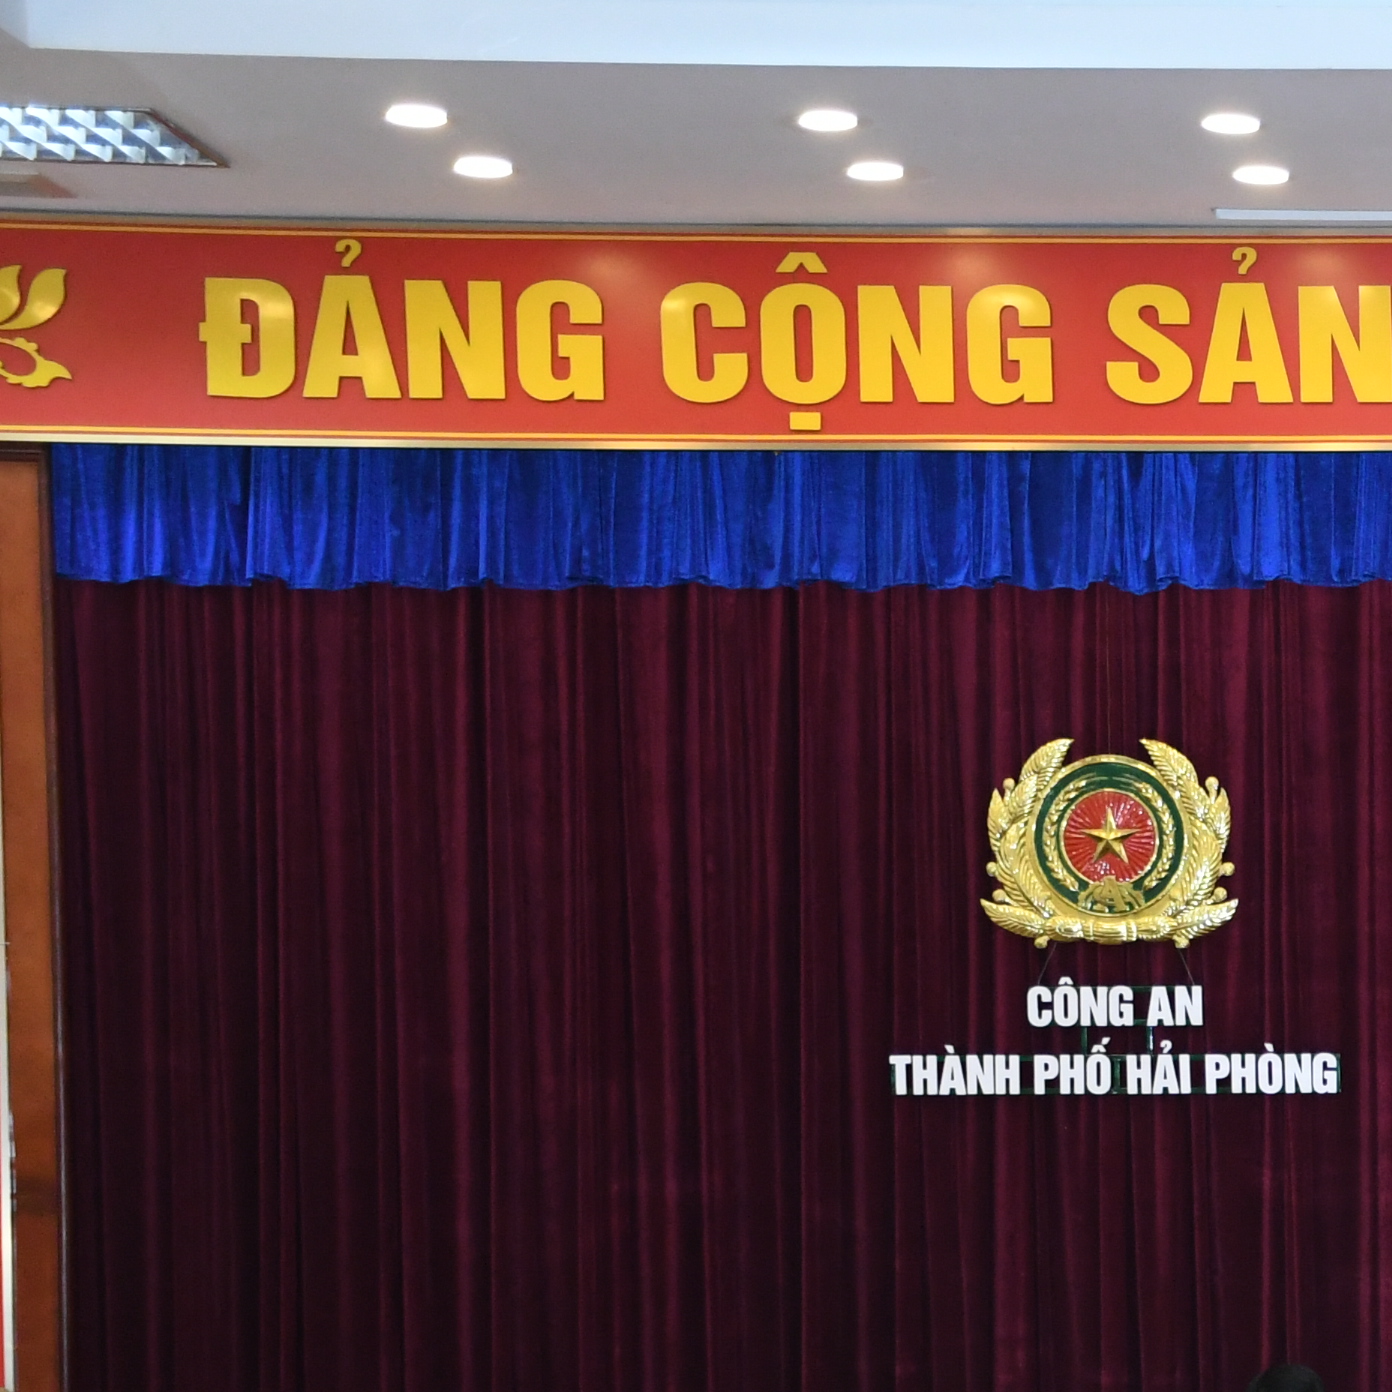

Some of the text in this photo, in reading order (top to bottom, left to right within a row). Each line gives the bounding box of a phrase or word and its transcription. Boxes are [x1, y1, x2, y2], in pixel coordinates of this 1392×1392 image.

[199, 239, 603, 402] ĐẢNG
[660, 252, 1054, 431] CỘNG
[1027, 977, 1203, 1027] CÔNG AN
[889, 1036, 1337, 1095] THÀNH PHỐ HẢI PHÒNG
